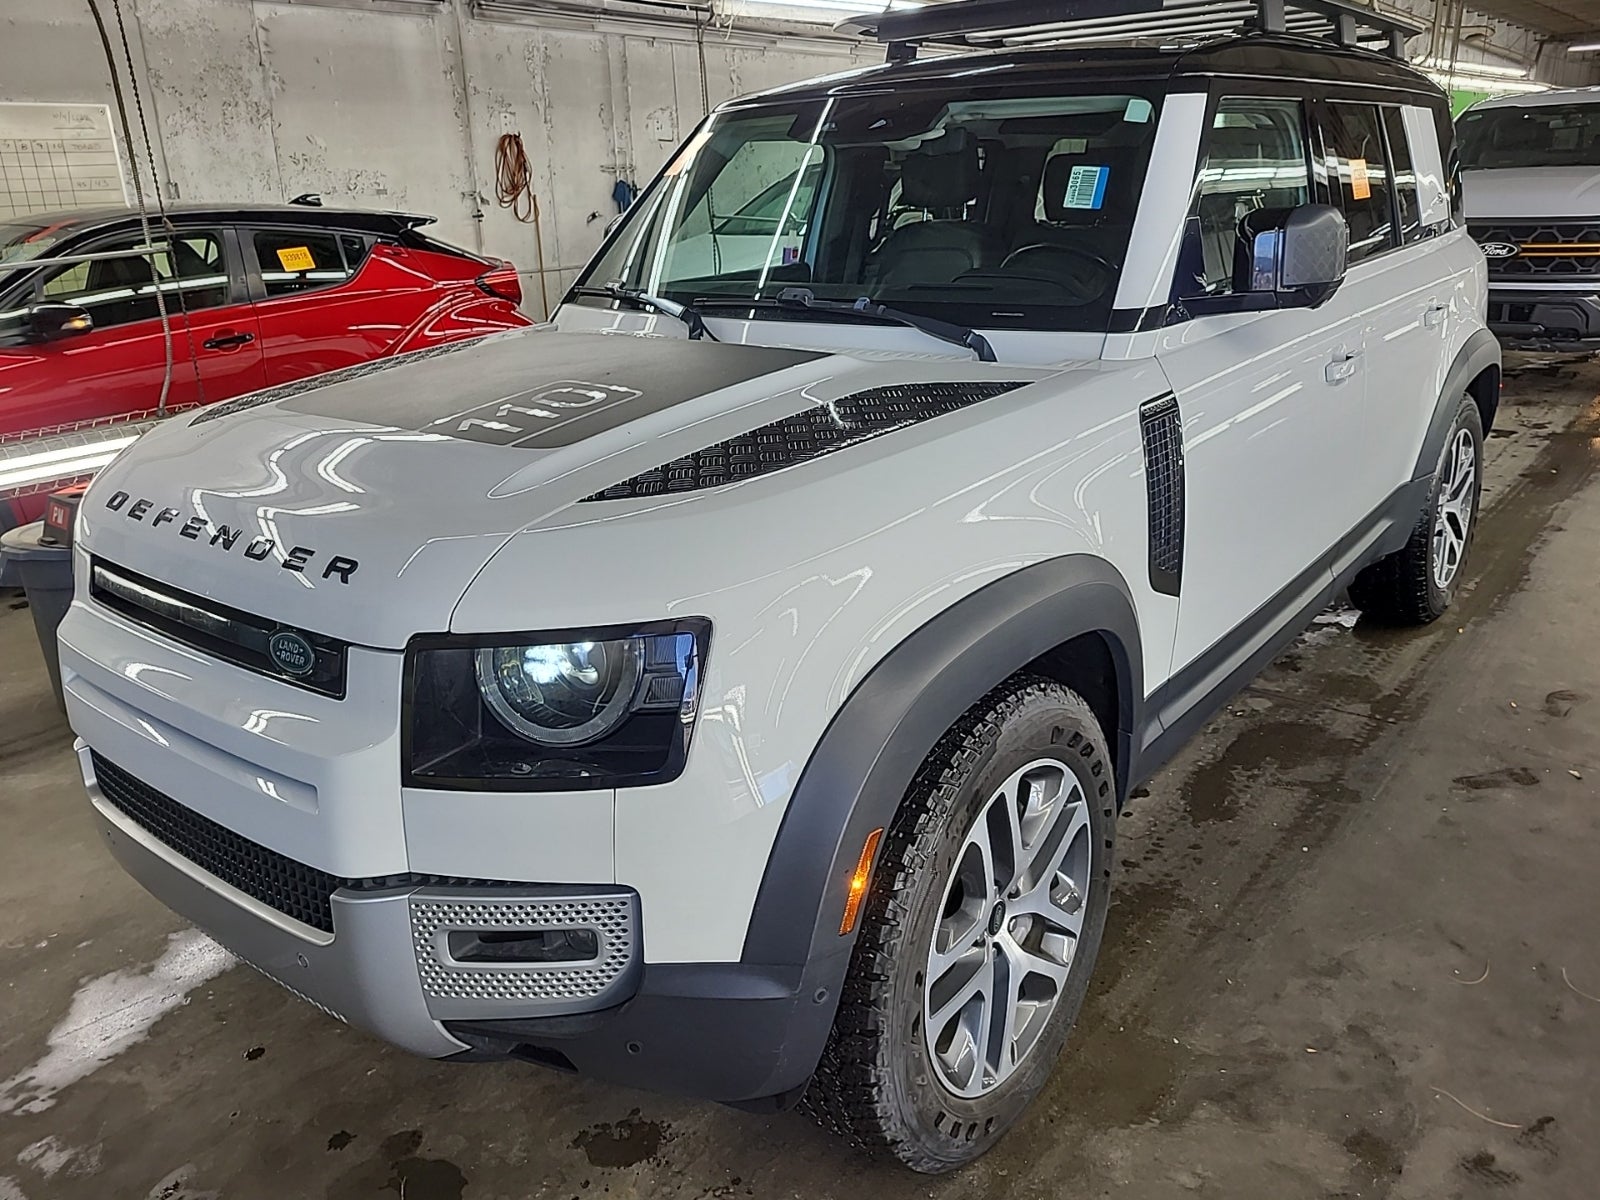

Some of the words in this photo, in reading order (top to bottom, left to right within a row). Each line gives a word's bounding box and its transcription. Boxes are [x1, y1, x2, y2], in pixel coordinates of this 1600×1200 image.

[1482, 244, 1510, 255] Ford
[456, 386, 609, 433] 110
[105, 490, 360, 585] DEFENDER
[278, 639, 299, 654] LAND
[280, 650, 305, 666] ROVER
